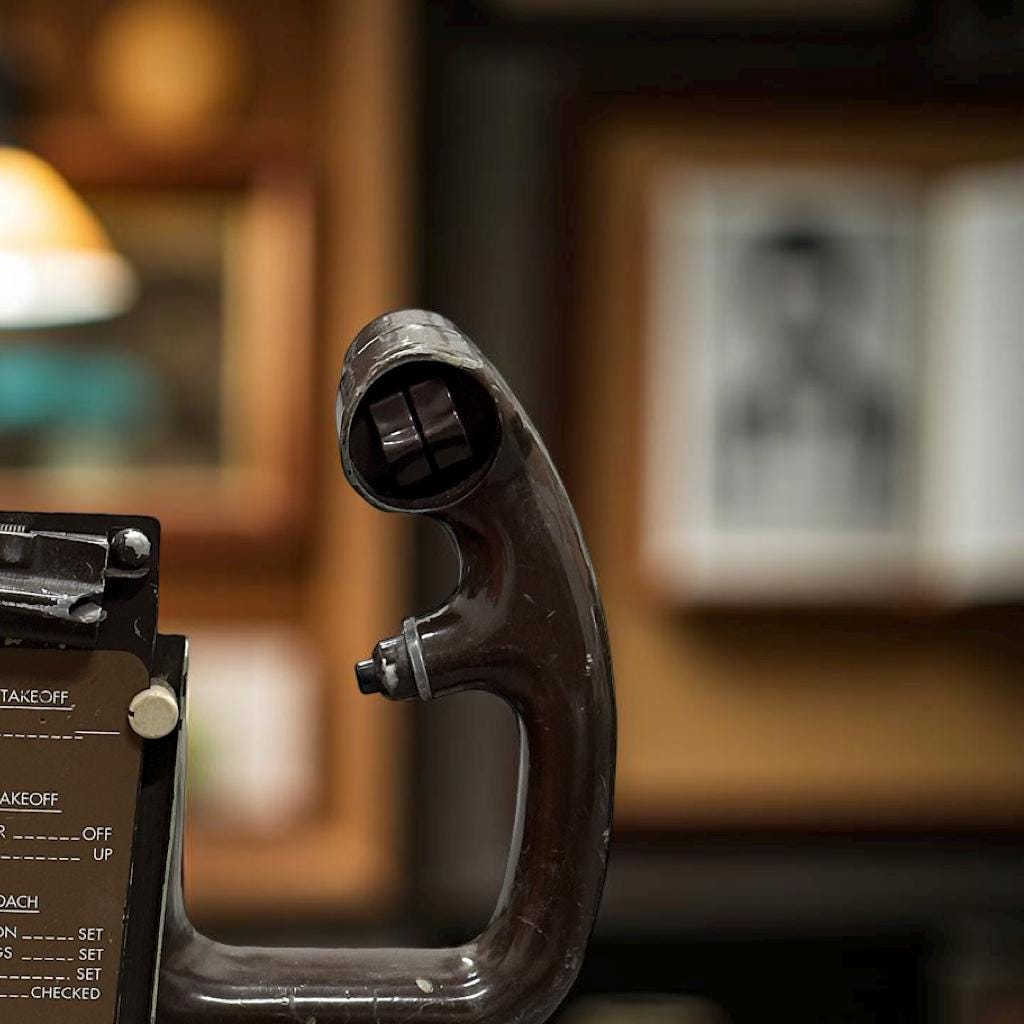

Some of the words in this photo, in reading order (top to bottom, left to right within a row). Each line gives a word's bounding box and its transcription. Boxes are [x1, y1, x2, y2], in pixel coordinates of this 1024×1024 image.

[0, 689, 69, 705] TAKEOFF
[82, 826, 112, 841] OFF
[93, 847, 113, 861] UP
[78, 928, 103, 941] SET
[78, 948, 104, 961] SET
[77, 968, 102, 981] SET
[31, 986, 101, 1000] CHECKED
